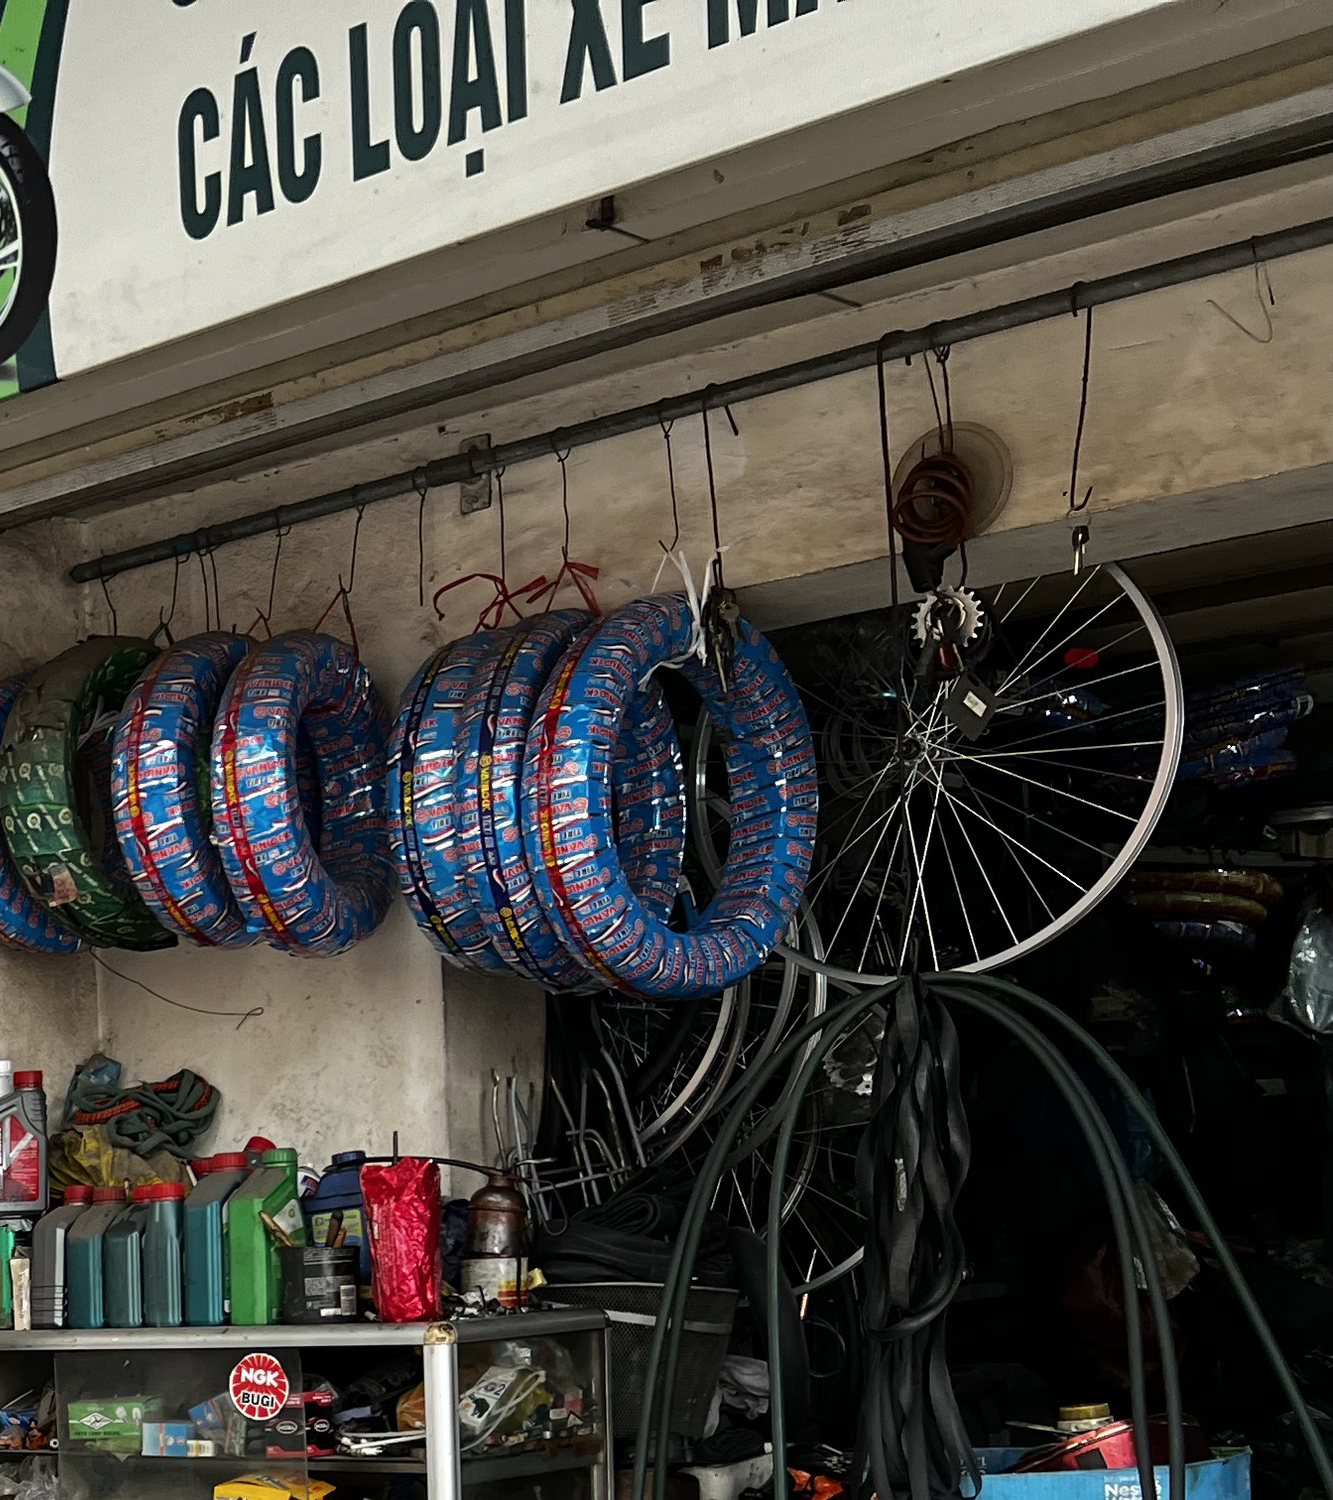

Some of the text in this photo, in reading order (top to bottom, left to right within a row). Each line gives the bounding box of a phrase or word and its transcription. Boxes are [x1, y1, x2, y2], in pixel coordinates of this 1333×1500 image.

[176, 30, 323, 241] CÁC
[348, 0, 530, 179] LOẠI
[240, 1368, 279, 1387] NGK
[241, 1391, 276, 1409] BUGI
